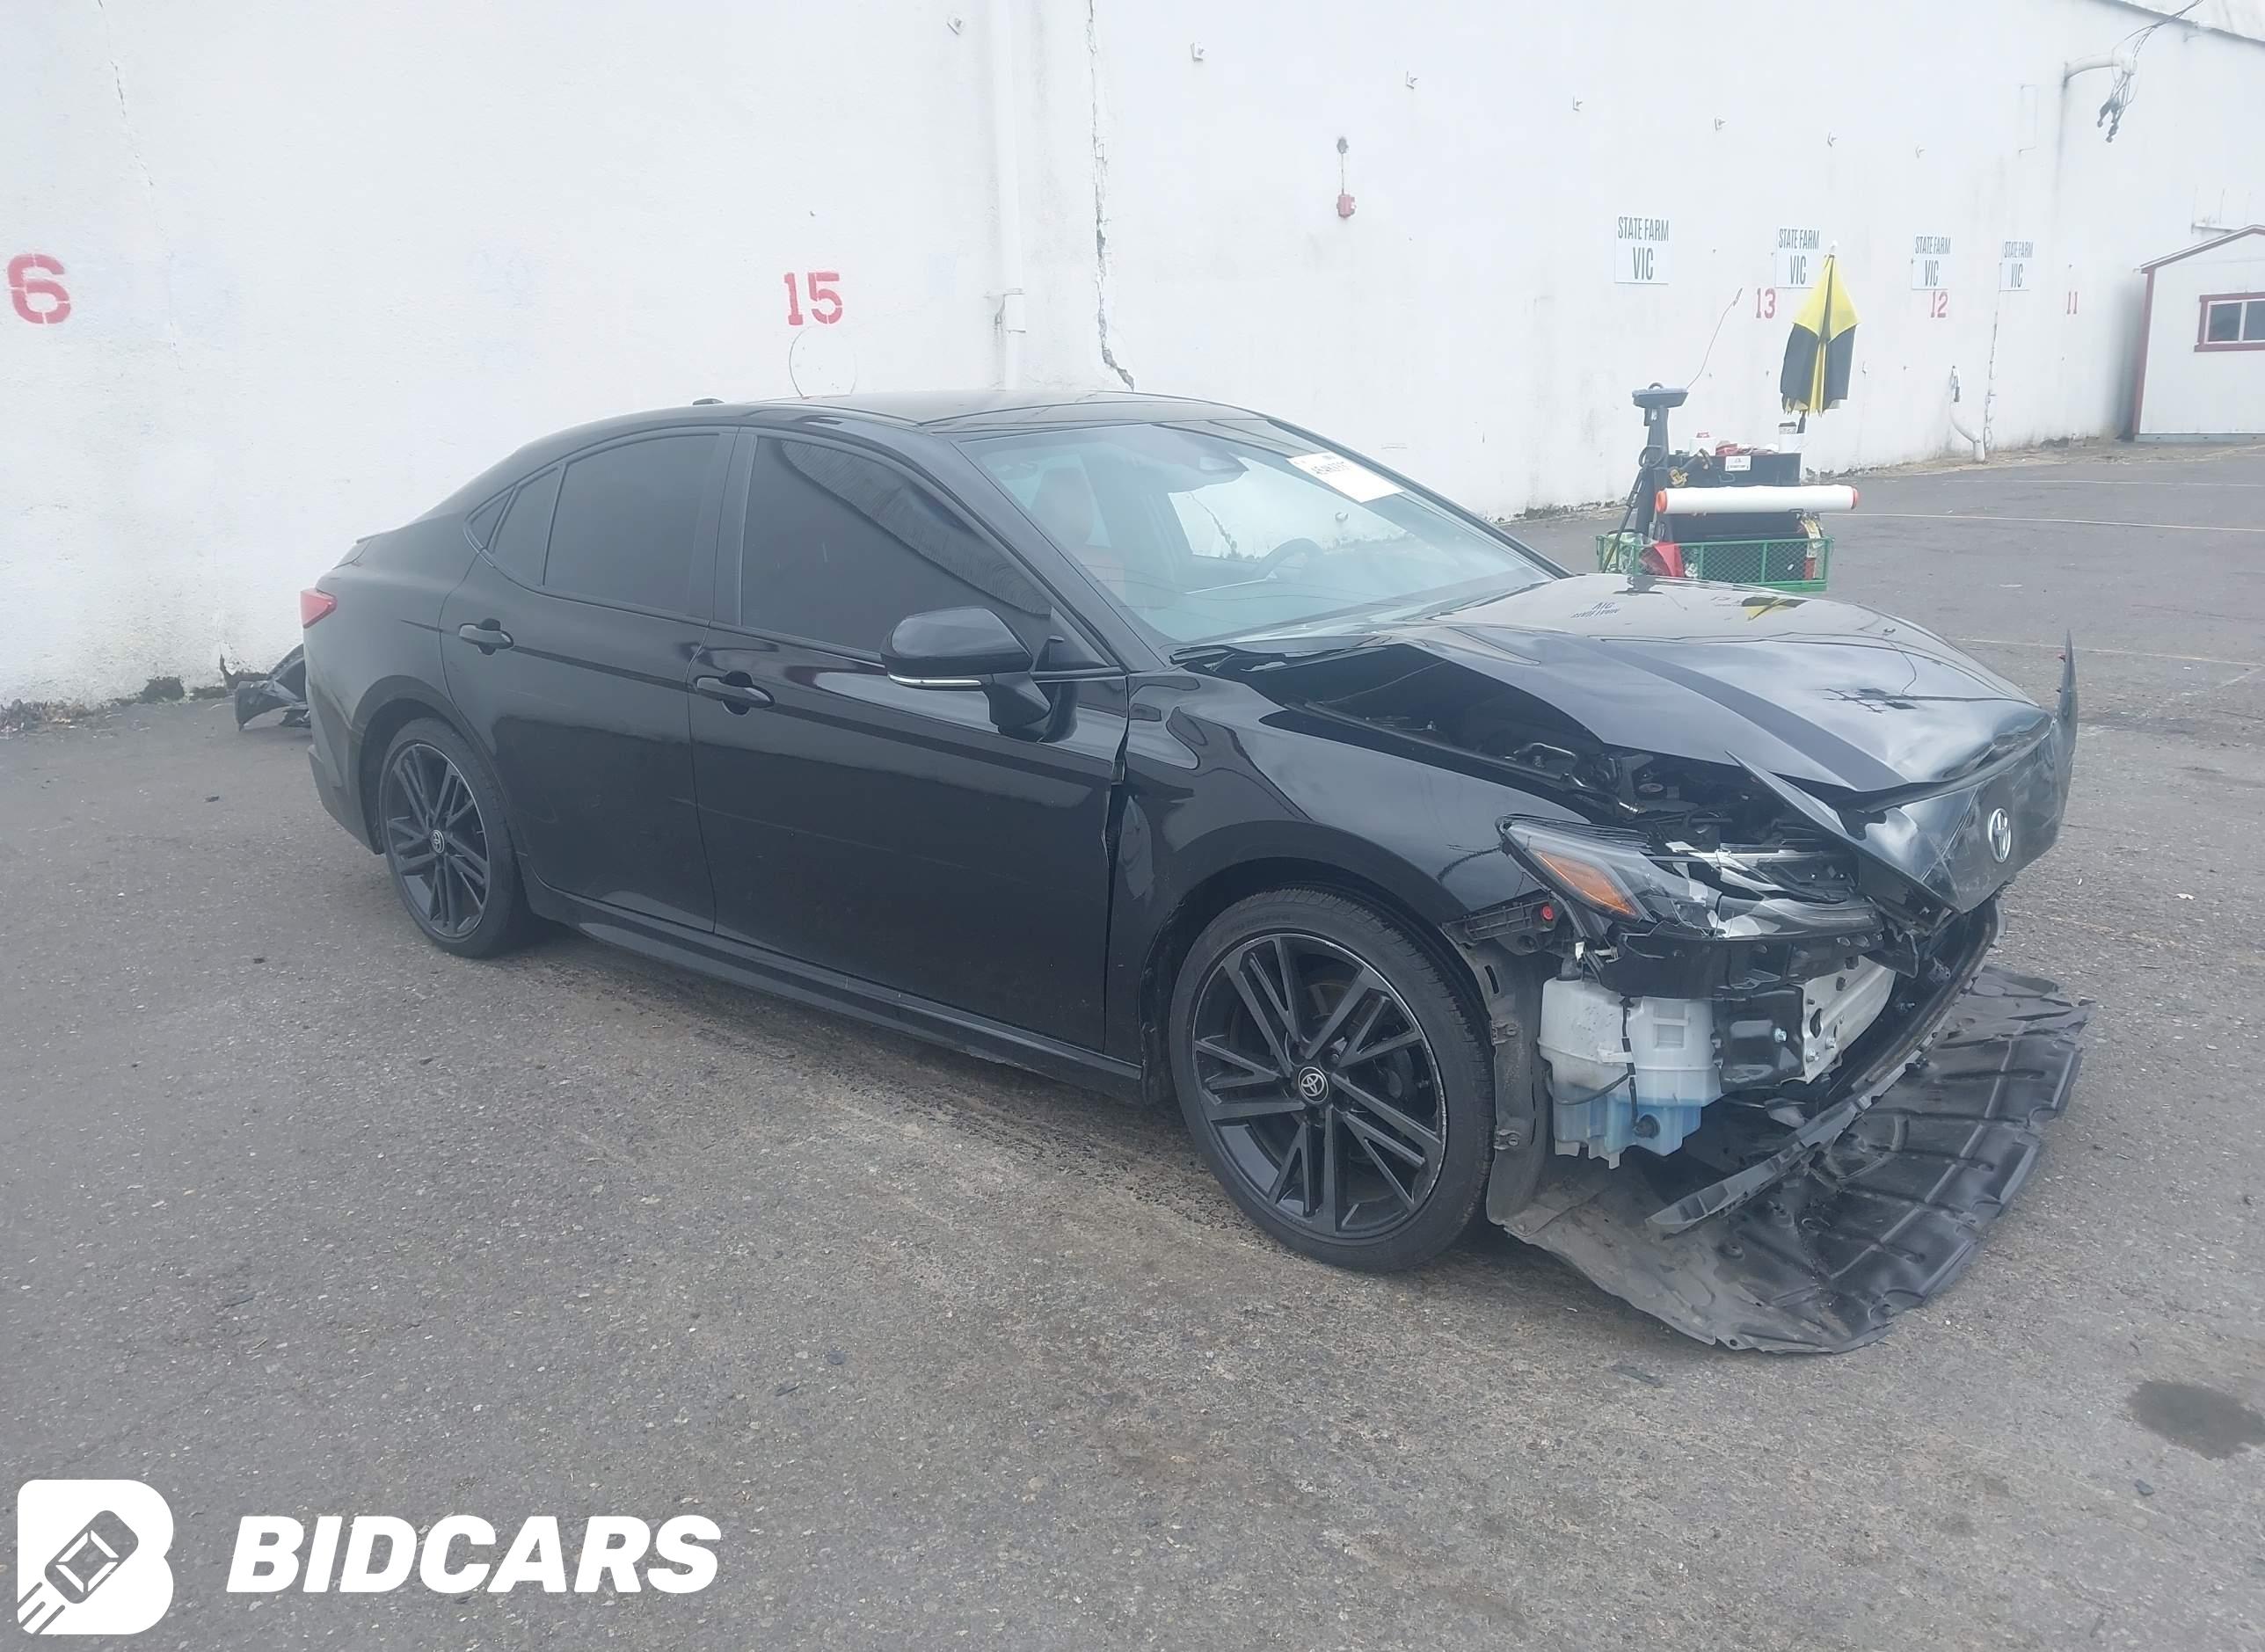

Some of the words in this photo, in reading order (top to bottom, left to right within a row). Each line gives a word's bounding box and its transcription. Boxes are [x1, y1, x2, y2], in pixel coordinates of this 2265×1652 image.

[1618, 216, 1643, 240] STATE
[1644, 218, 1669, 242] FARM
[1778, 228, 1798, 250] STATE
[1799, 229, 1820, 250] FARM
[1915, 236, 1934, 254] STATE
[1934, 237, 1951, 255] FARM
[1632, 246, 1654, 280] VIC
[1789, 255, 1807, 285] VIC
[1925, 259, 1939, 287] VIC
[2011, 263, 2023, 288] VIC
[7, 253, 71, 324] 6
[783, 272, 843, 326] 15
[1755, 287, 1776, 319] 13
[1930, 288, 1948, 318] 12
[2066, 291, 2078, 315] 11
